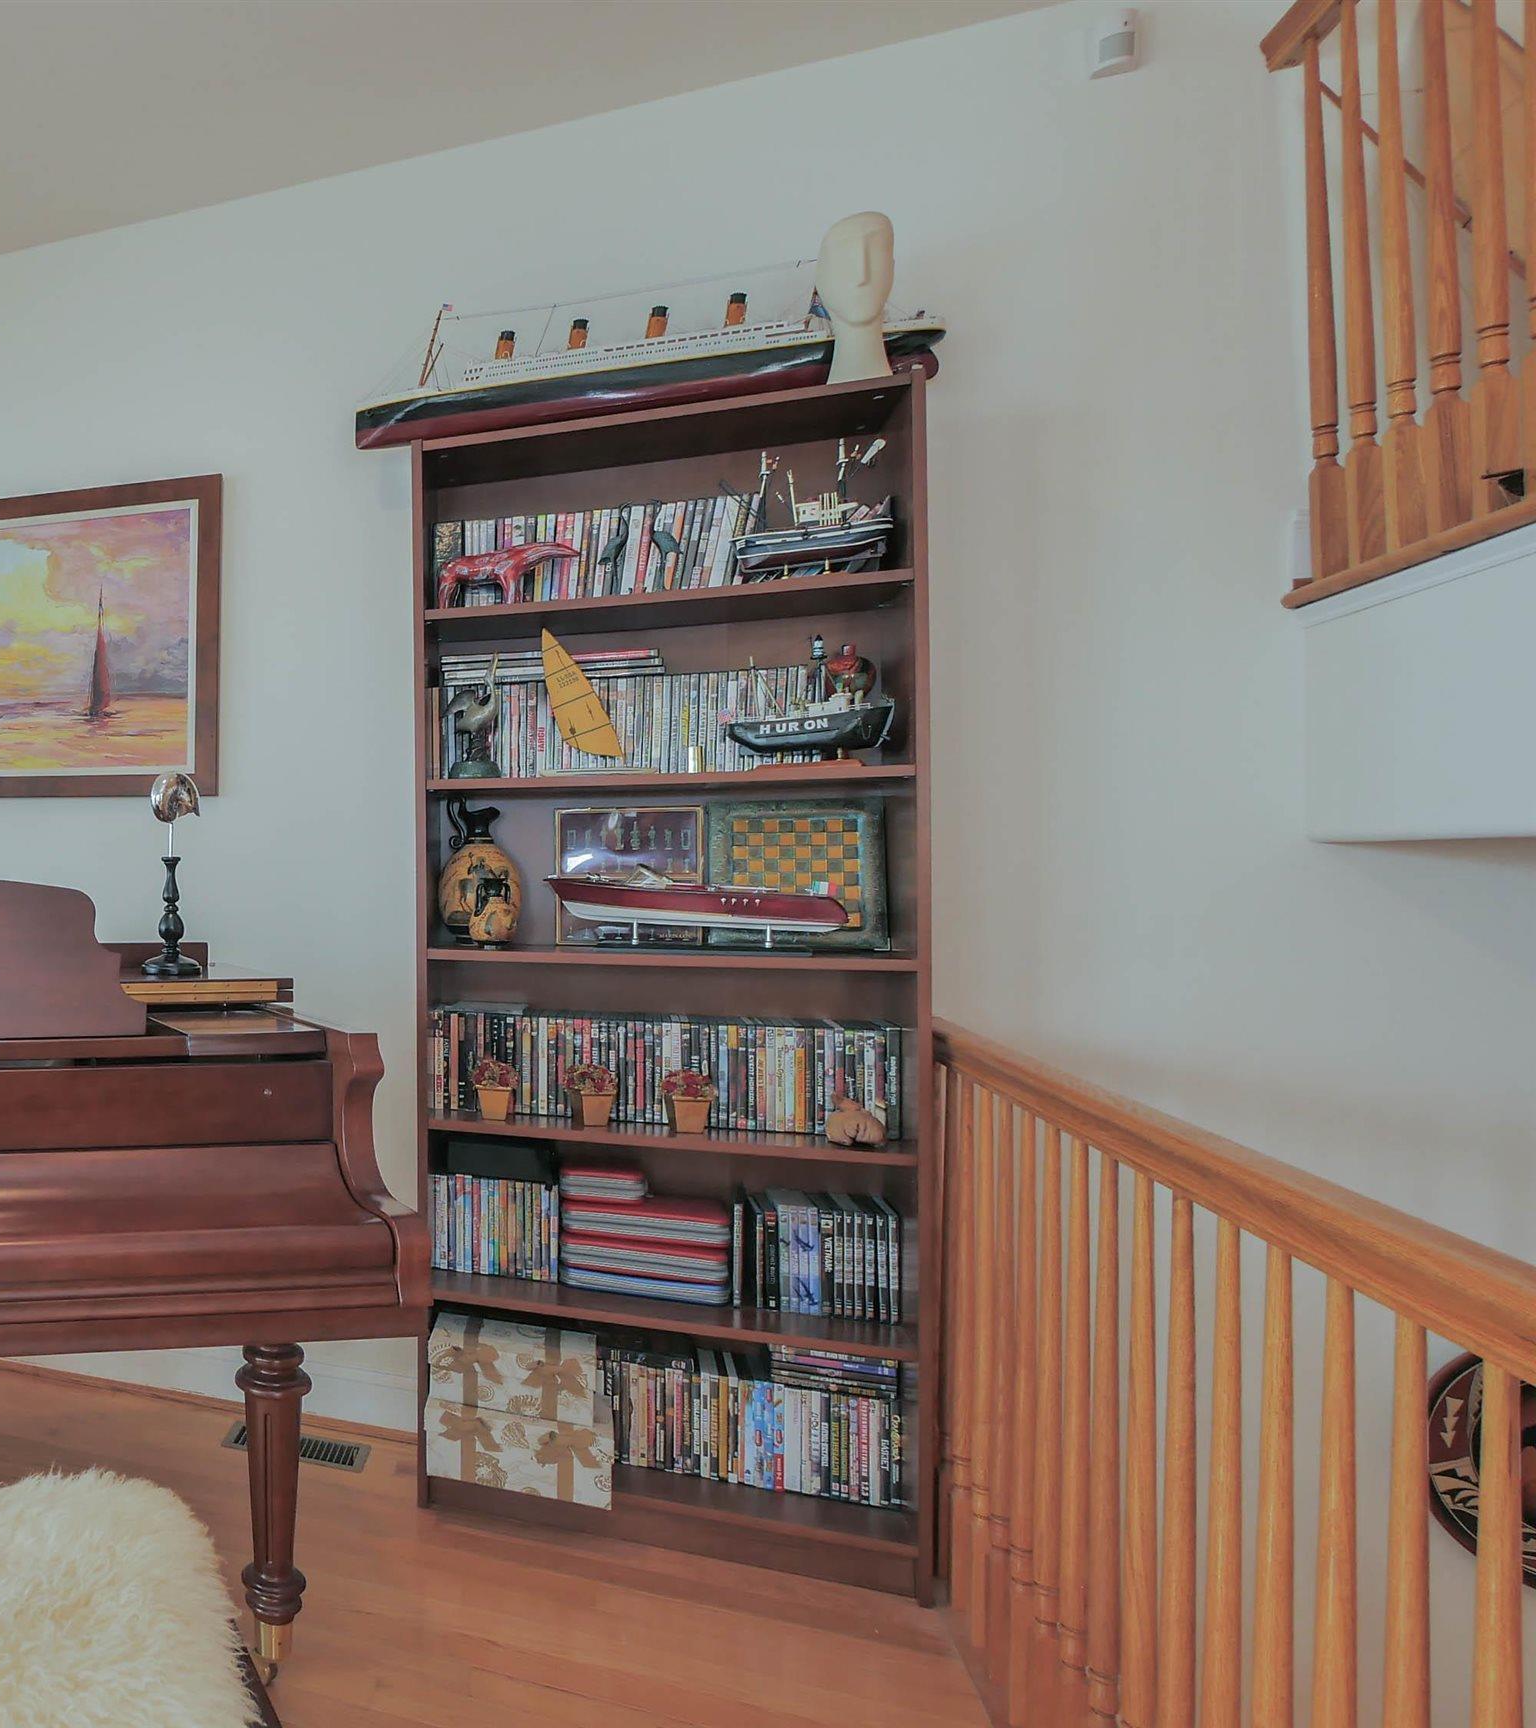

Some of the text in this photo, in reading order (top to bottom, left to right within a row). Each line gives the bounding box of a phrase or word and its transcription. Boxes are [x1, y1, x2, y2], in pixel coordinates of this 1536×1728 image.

[537, 726, 545, 753] FARGO
[759, 717, 829, 735] HURON
[824, 1236, 833, 1273] VIETNAM:
